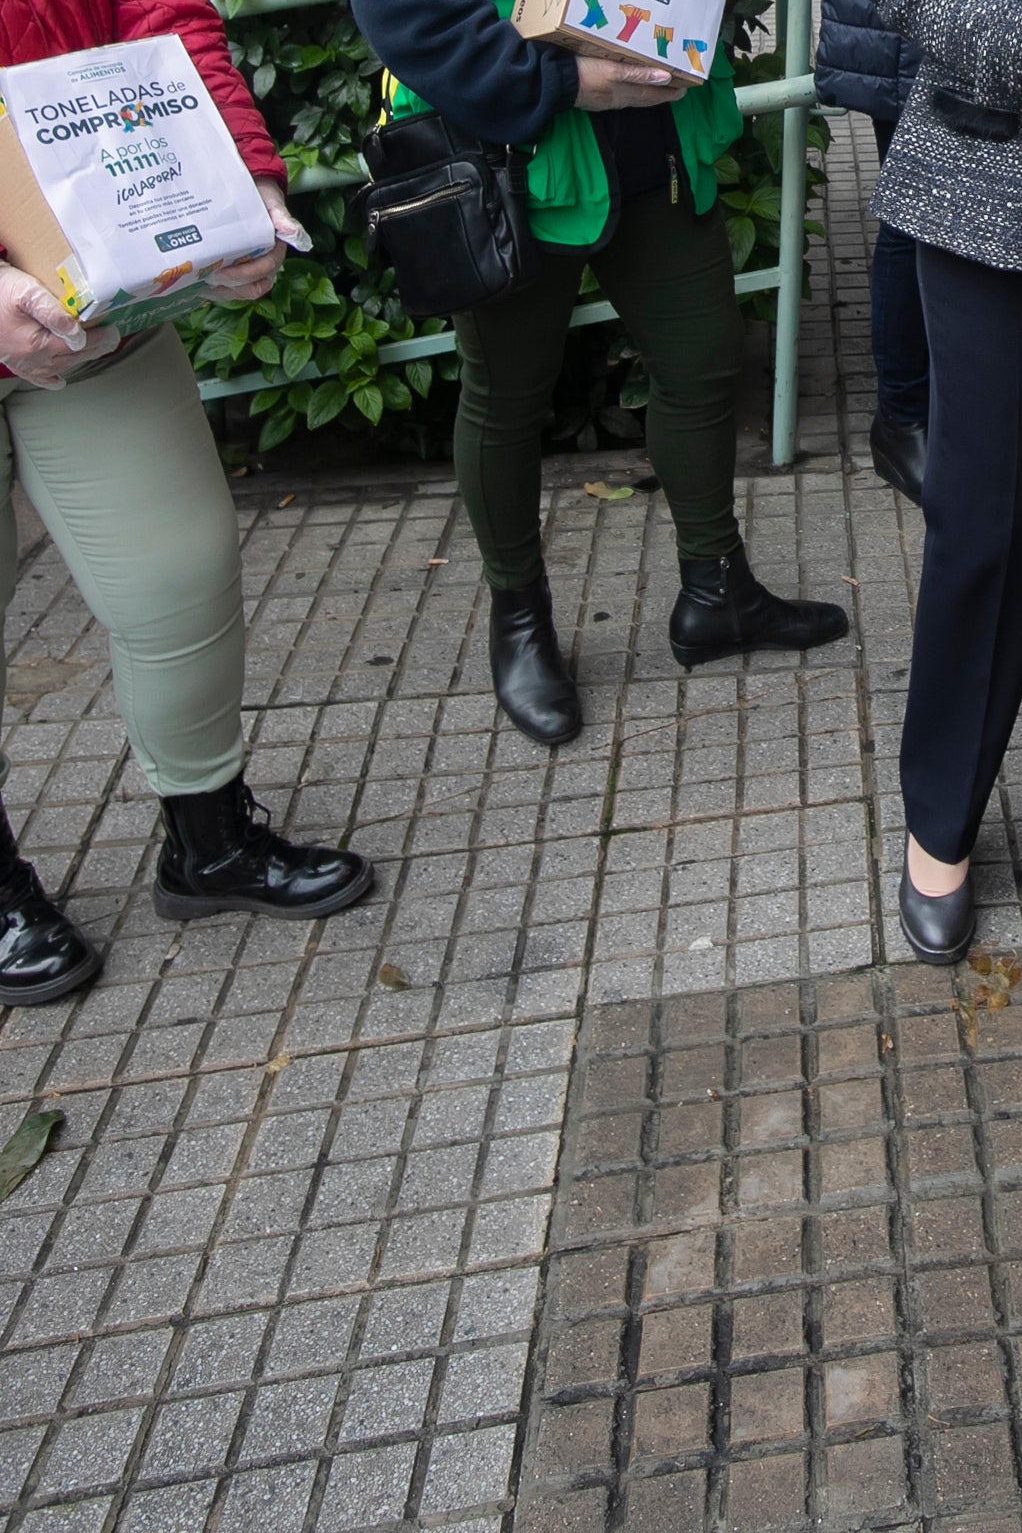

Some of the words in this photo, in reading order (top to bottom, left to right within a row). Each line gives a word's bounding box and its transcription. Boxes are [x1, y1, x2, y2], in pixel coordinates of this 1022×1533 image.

[80, 66, 126, 82] ALIMENTOS
[24, 81, 164, 125] TONELADAS
[166, 80, 186, 94] de
[36, 94, 199, 145] COMPROMISO
[100, 148, 114, 162] A
[116, 142, 142, 160] por
[144, 137, 168, 151] los
[170, 232, 200, 248] ONCE
